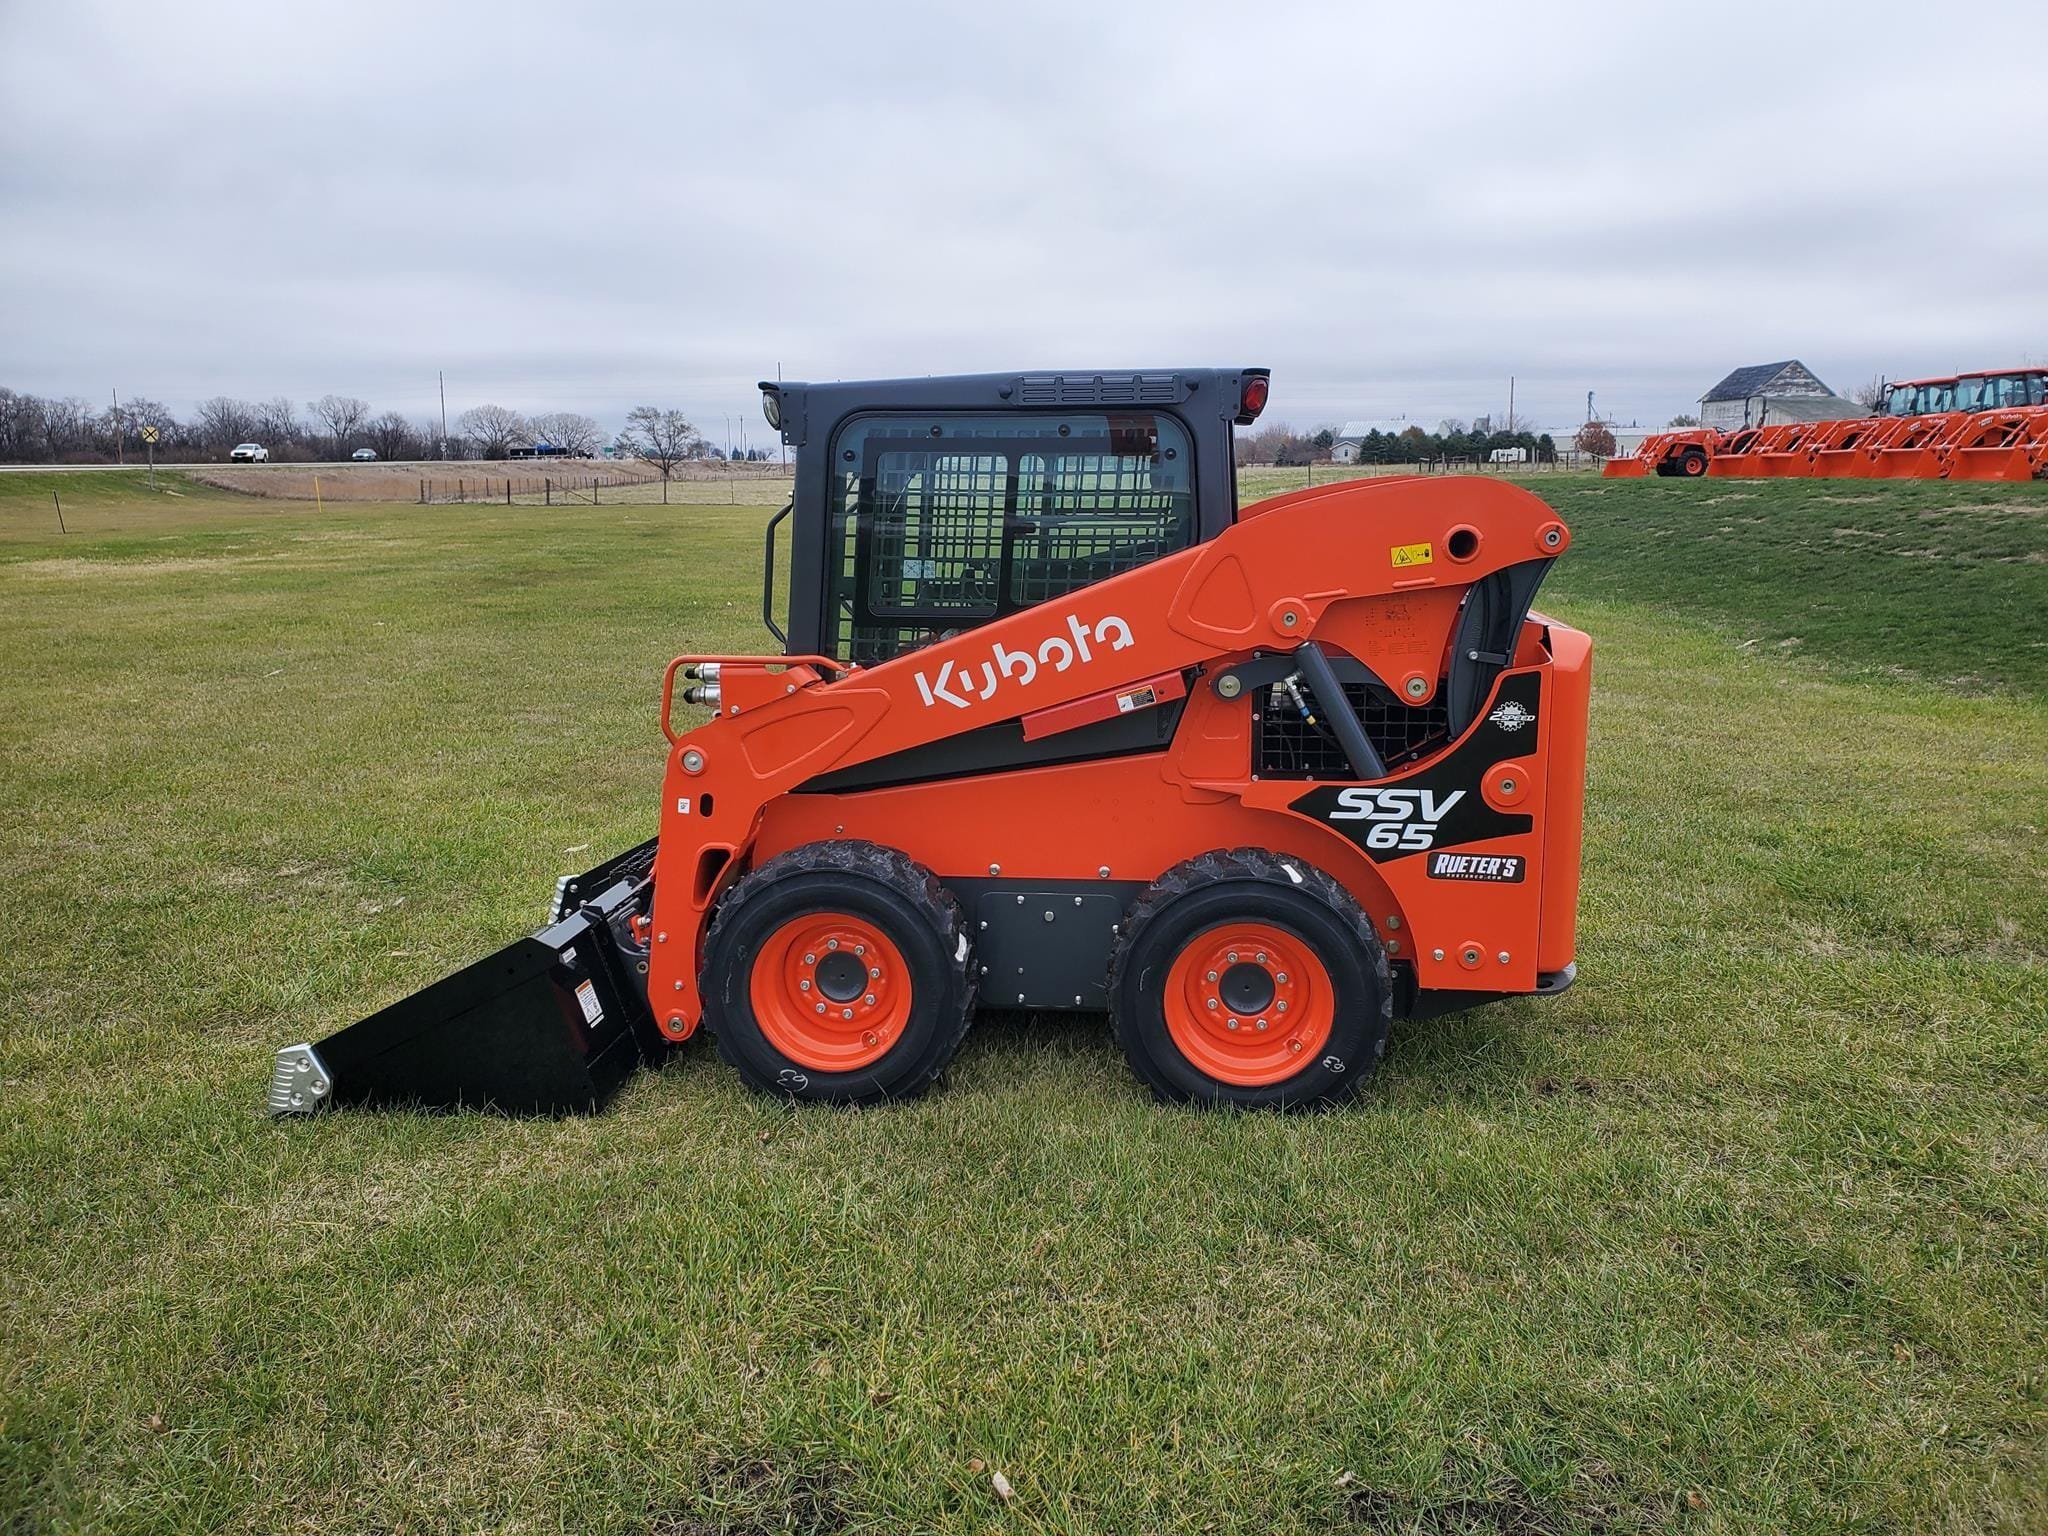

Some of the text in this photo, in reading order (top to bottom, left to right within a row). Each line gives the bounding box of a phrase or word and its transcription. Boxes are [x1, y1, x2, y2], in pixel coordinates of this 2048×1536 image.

[913, 614, 1135, 709] Kubota
[1329, 787, 1467, 822] SSV
[1366, 822, 1438, 850] 65
[1434, 853, 1518, 878] RUETER'S
